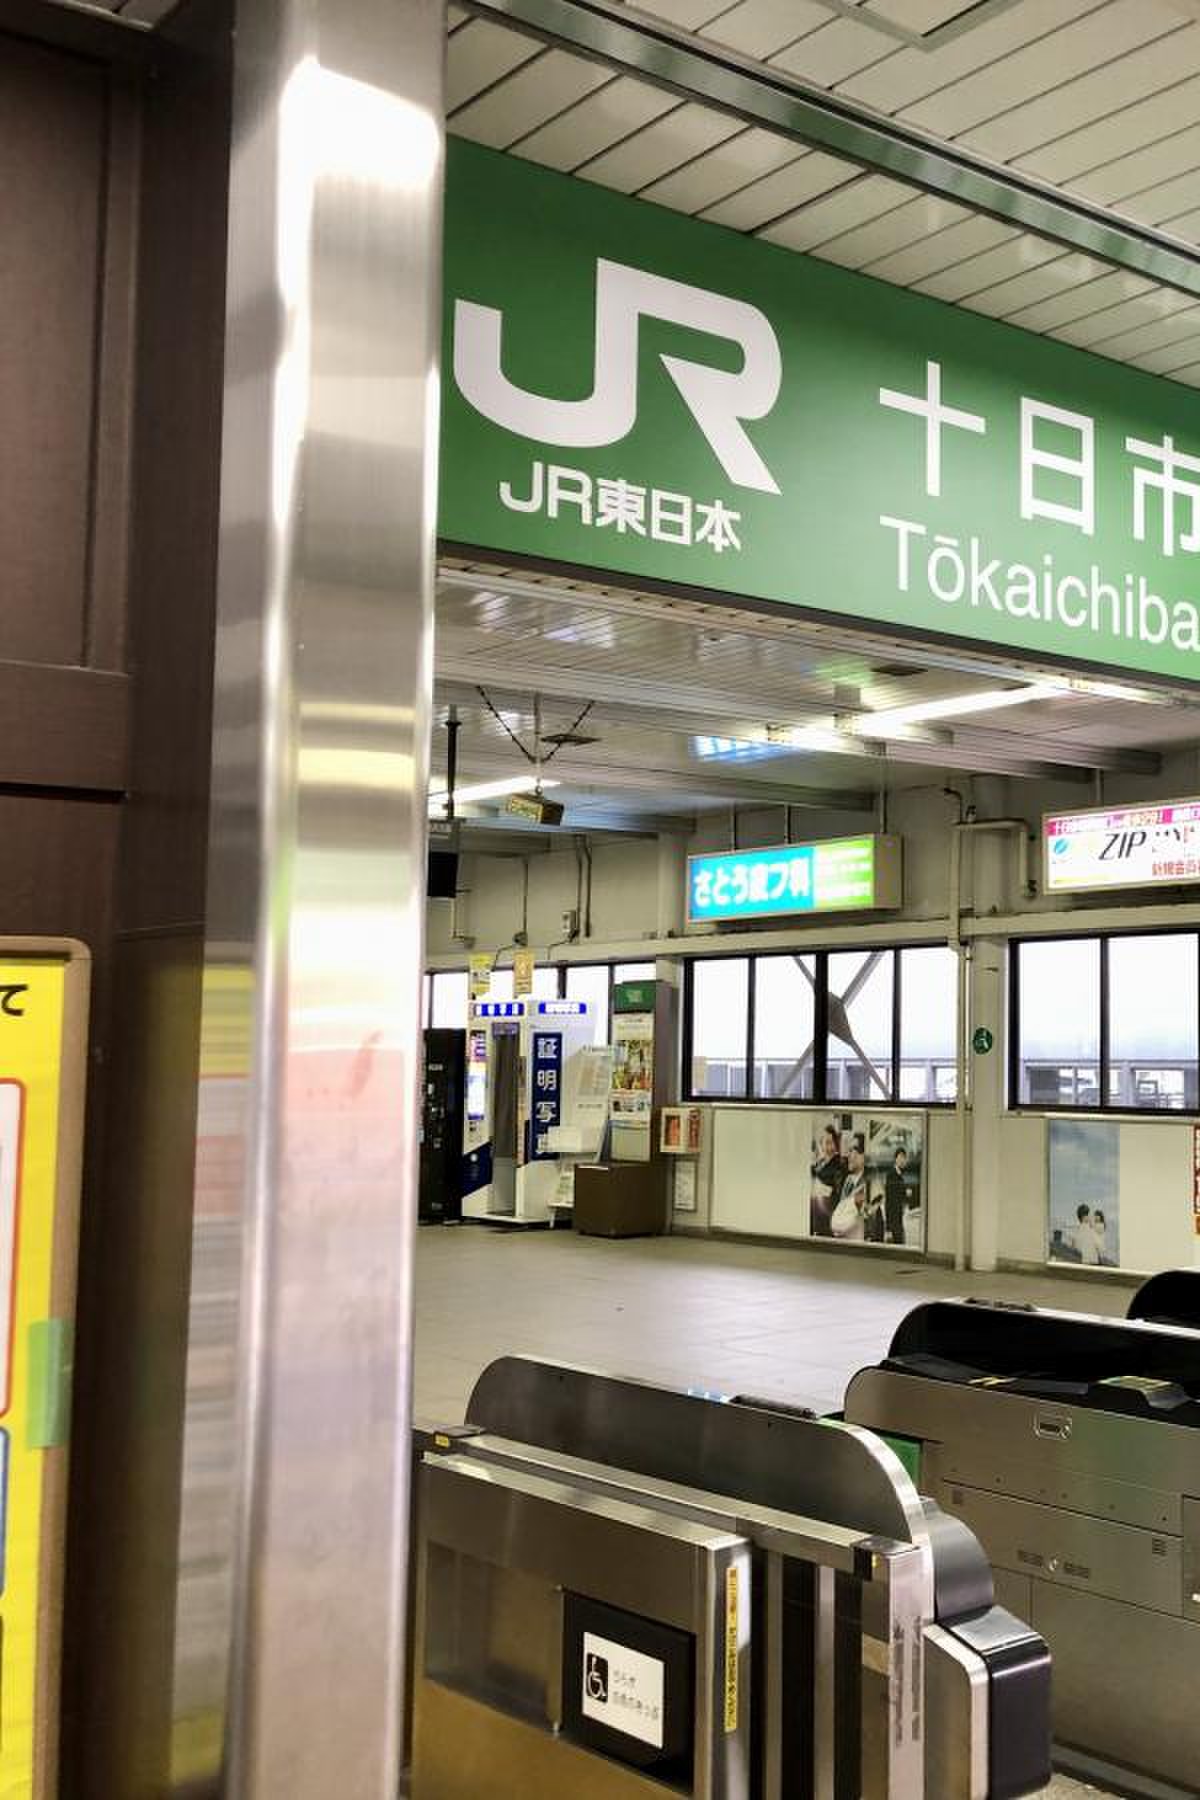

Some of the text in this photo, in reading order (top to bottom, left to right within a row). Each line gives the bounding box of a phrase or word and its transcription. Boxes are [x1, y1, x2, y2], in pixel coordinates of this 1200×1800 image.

[453, 258, 782, 495] JR
[500, 461, 741, 552] JR東日本
[879, 515, 1200, 653] Tōkaichiba
[1098, 831, 1148, 861] ZIP
